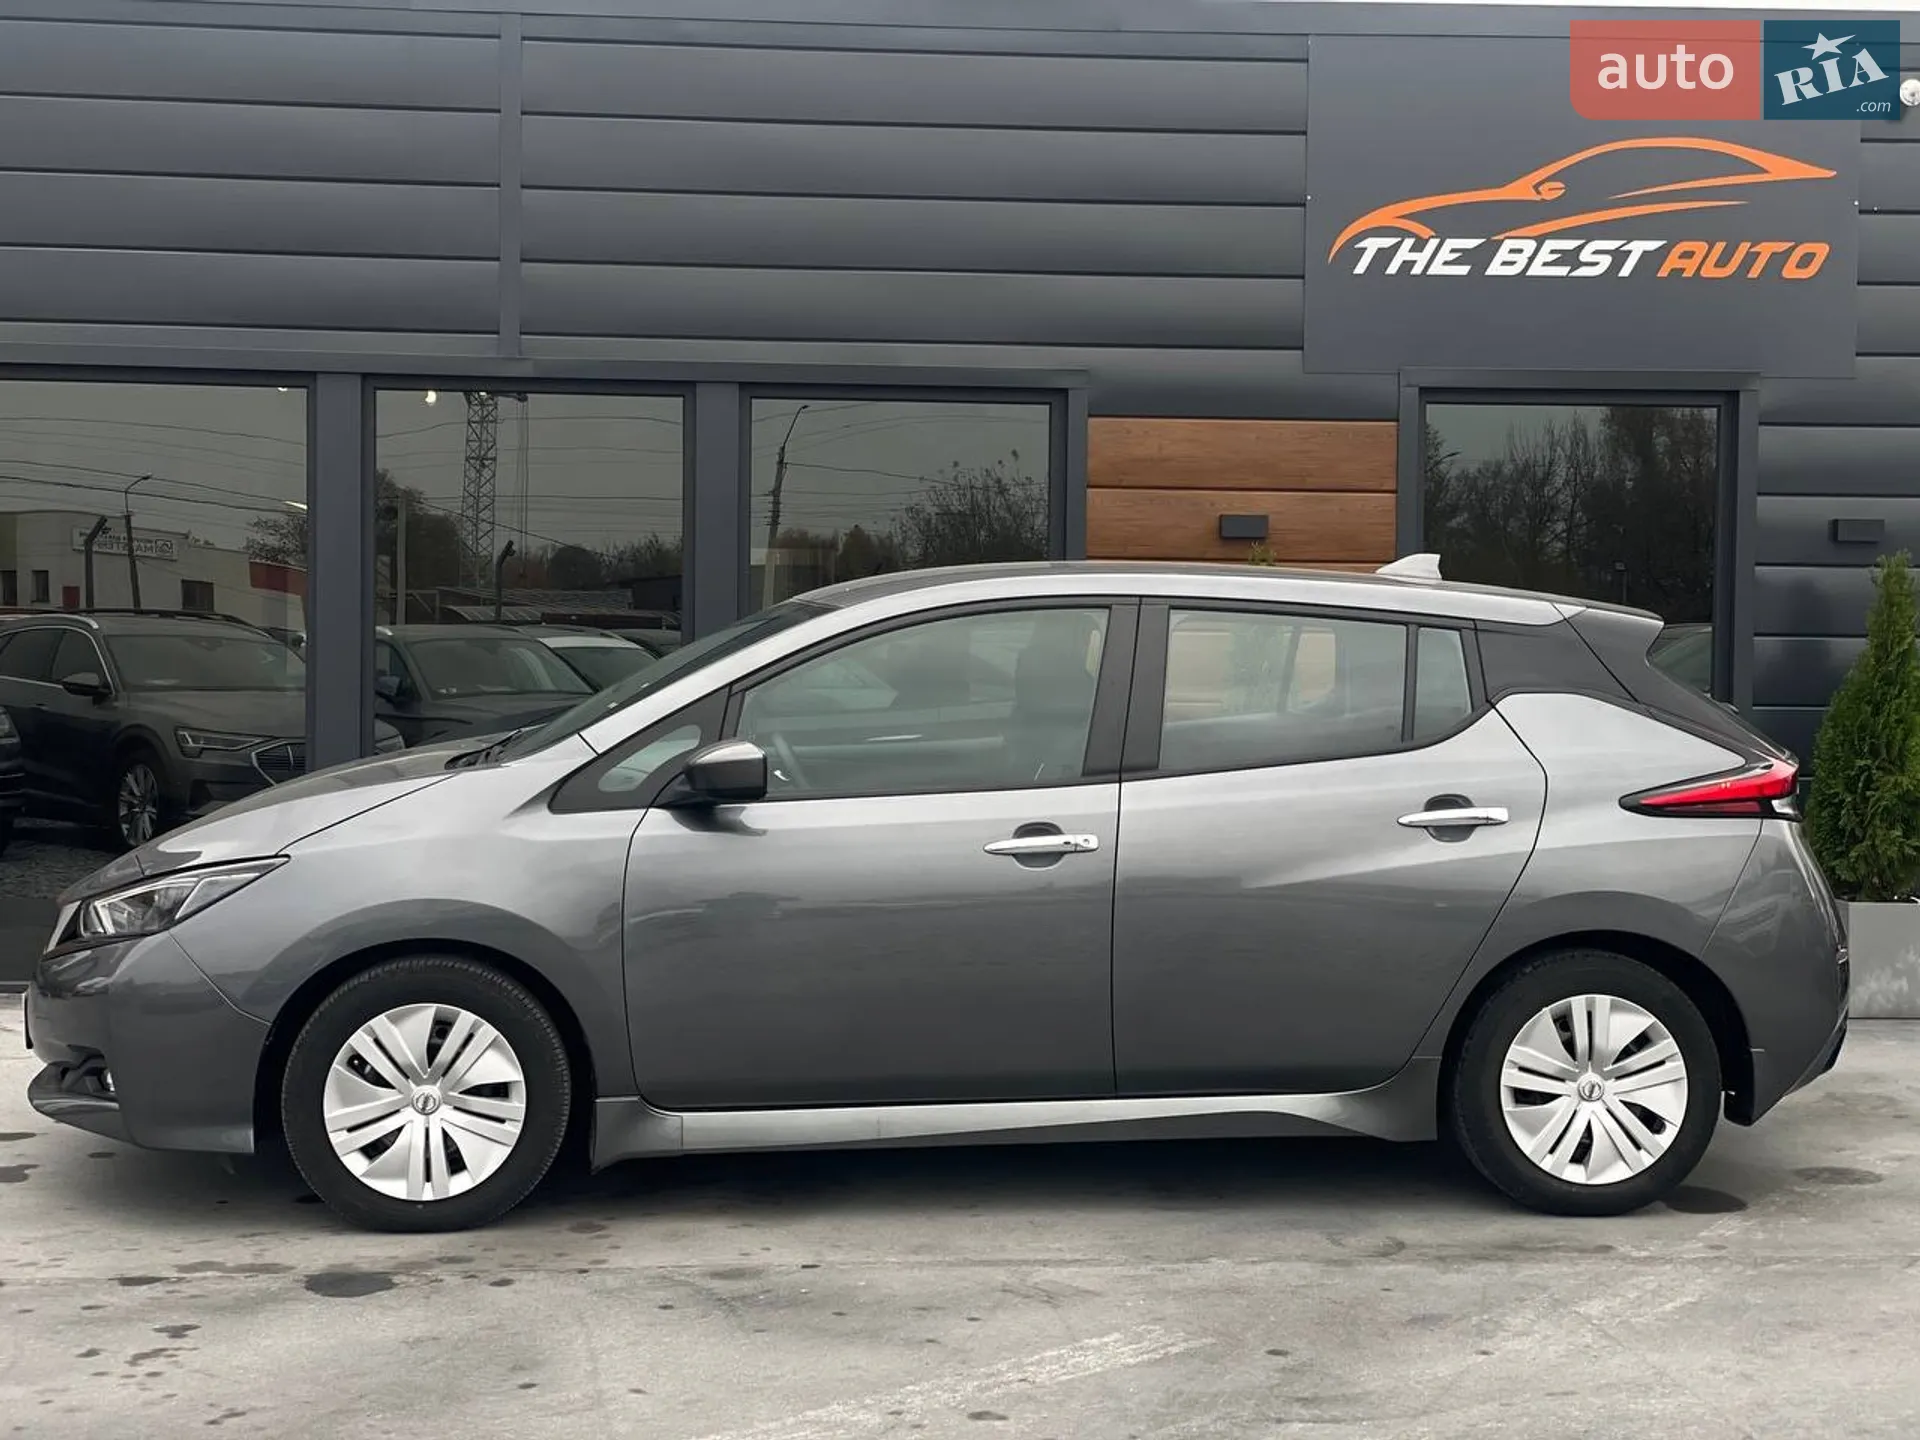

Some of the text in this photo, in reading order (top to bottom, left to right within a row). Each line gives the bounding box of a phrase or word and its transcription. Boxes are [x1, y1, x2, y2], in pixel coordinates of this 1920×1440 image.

[1352, 237, 1831, 279] THE BEST AUTO
